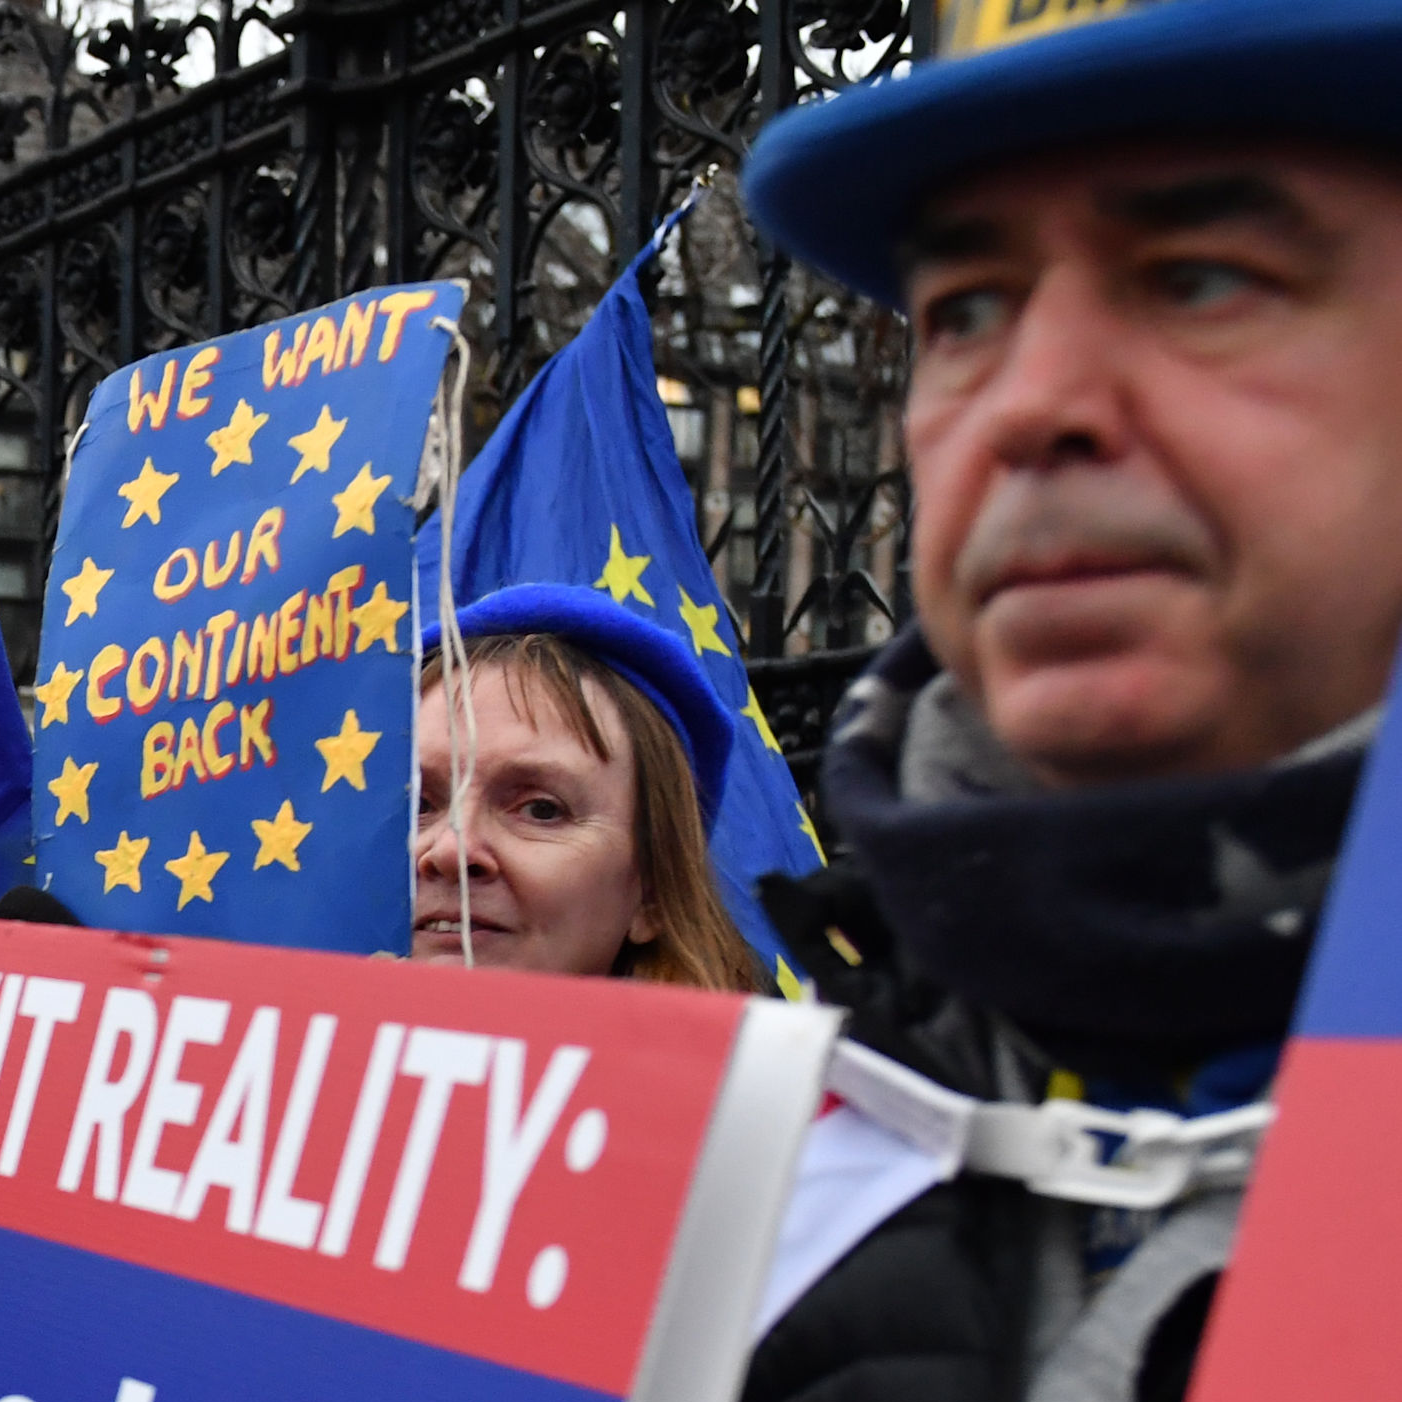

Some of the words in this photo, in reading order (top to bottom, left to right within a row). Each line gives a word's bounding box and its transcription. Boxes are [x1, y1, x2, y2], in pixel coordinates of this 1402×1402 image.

[127, 345, 221, 433] WE
[263, 290, 436, 392] WANT
[153, 506, 286, 604] OUR
[86, 564, 365, 724] CONTINENT
[141, 698, 276, 800] BACK
[57, 986, 609, 1309] REALITY:
